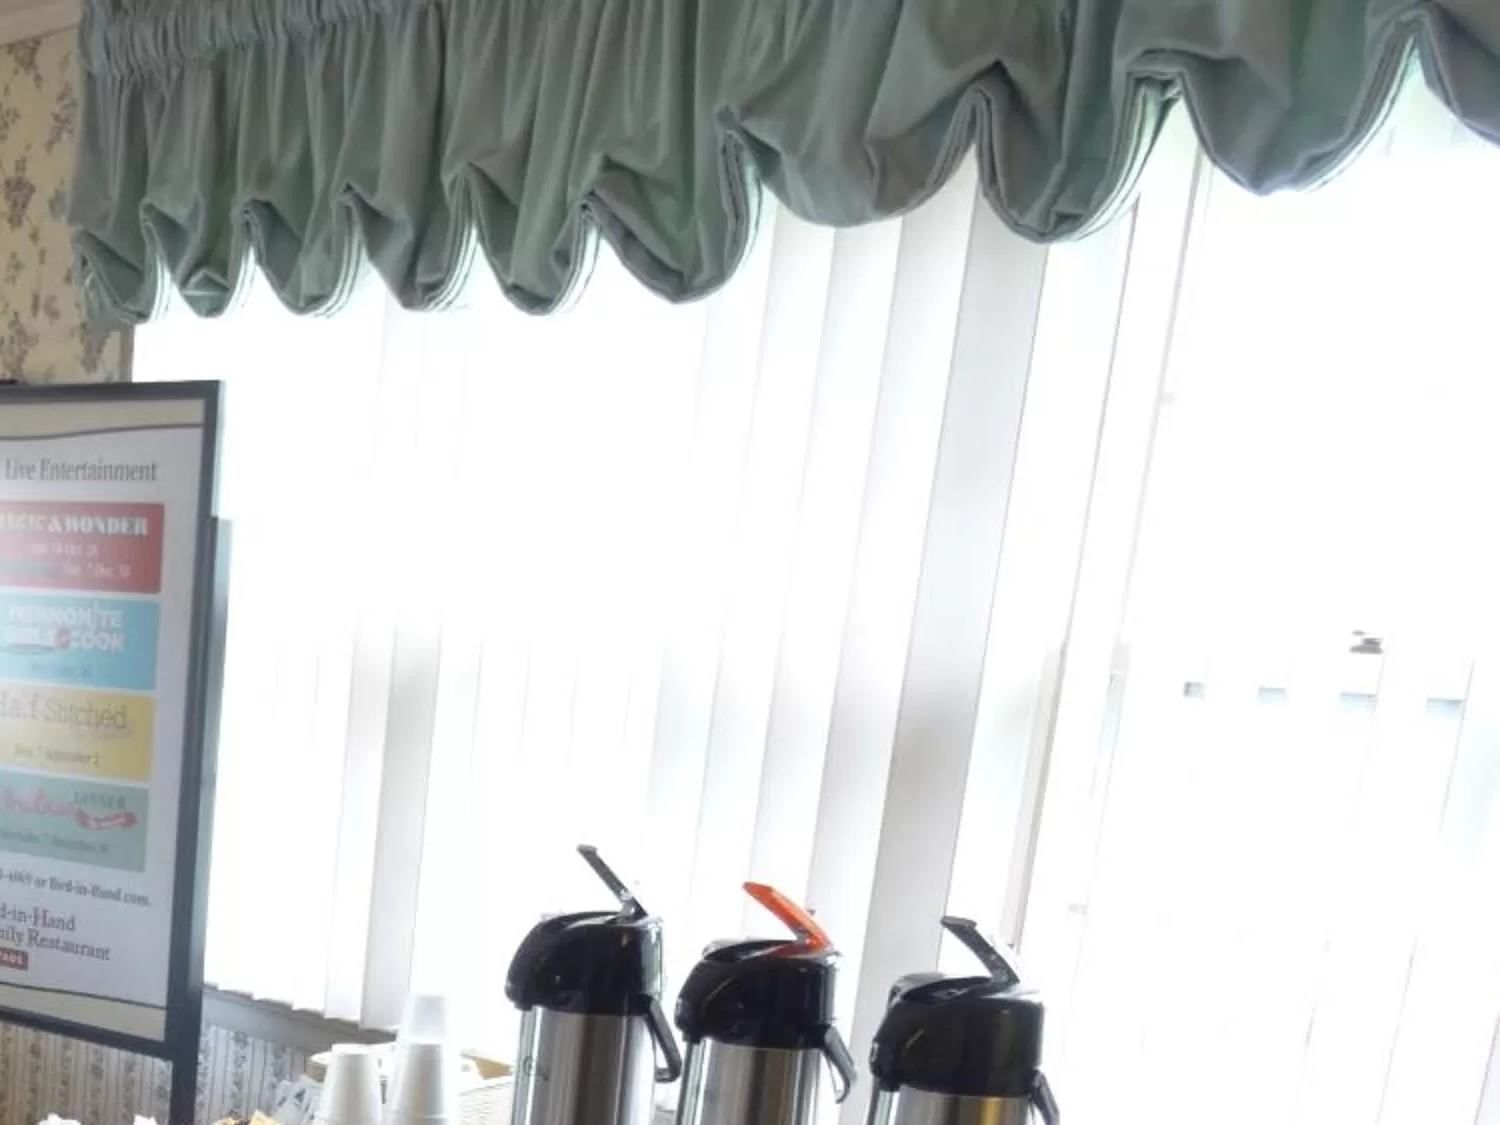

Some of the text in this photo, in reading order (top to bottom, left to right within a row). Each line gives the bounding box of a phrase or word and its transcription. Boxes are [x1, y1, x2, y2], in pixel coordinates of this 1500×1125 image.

[5, 457, 35, 481] Live
[39, 457, 157, 482] Entertainment
[28, 929, 111, 961] Restaurant
